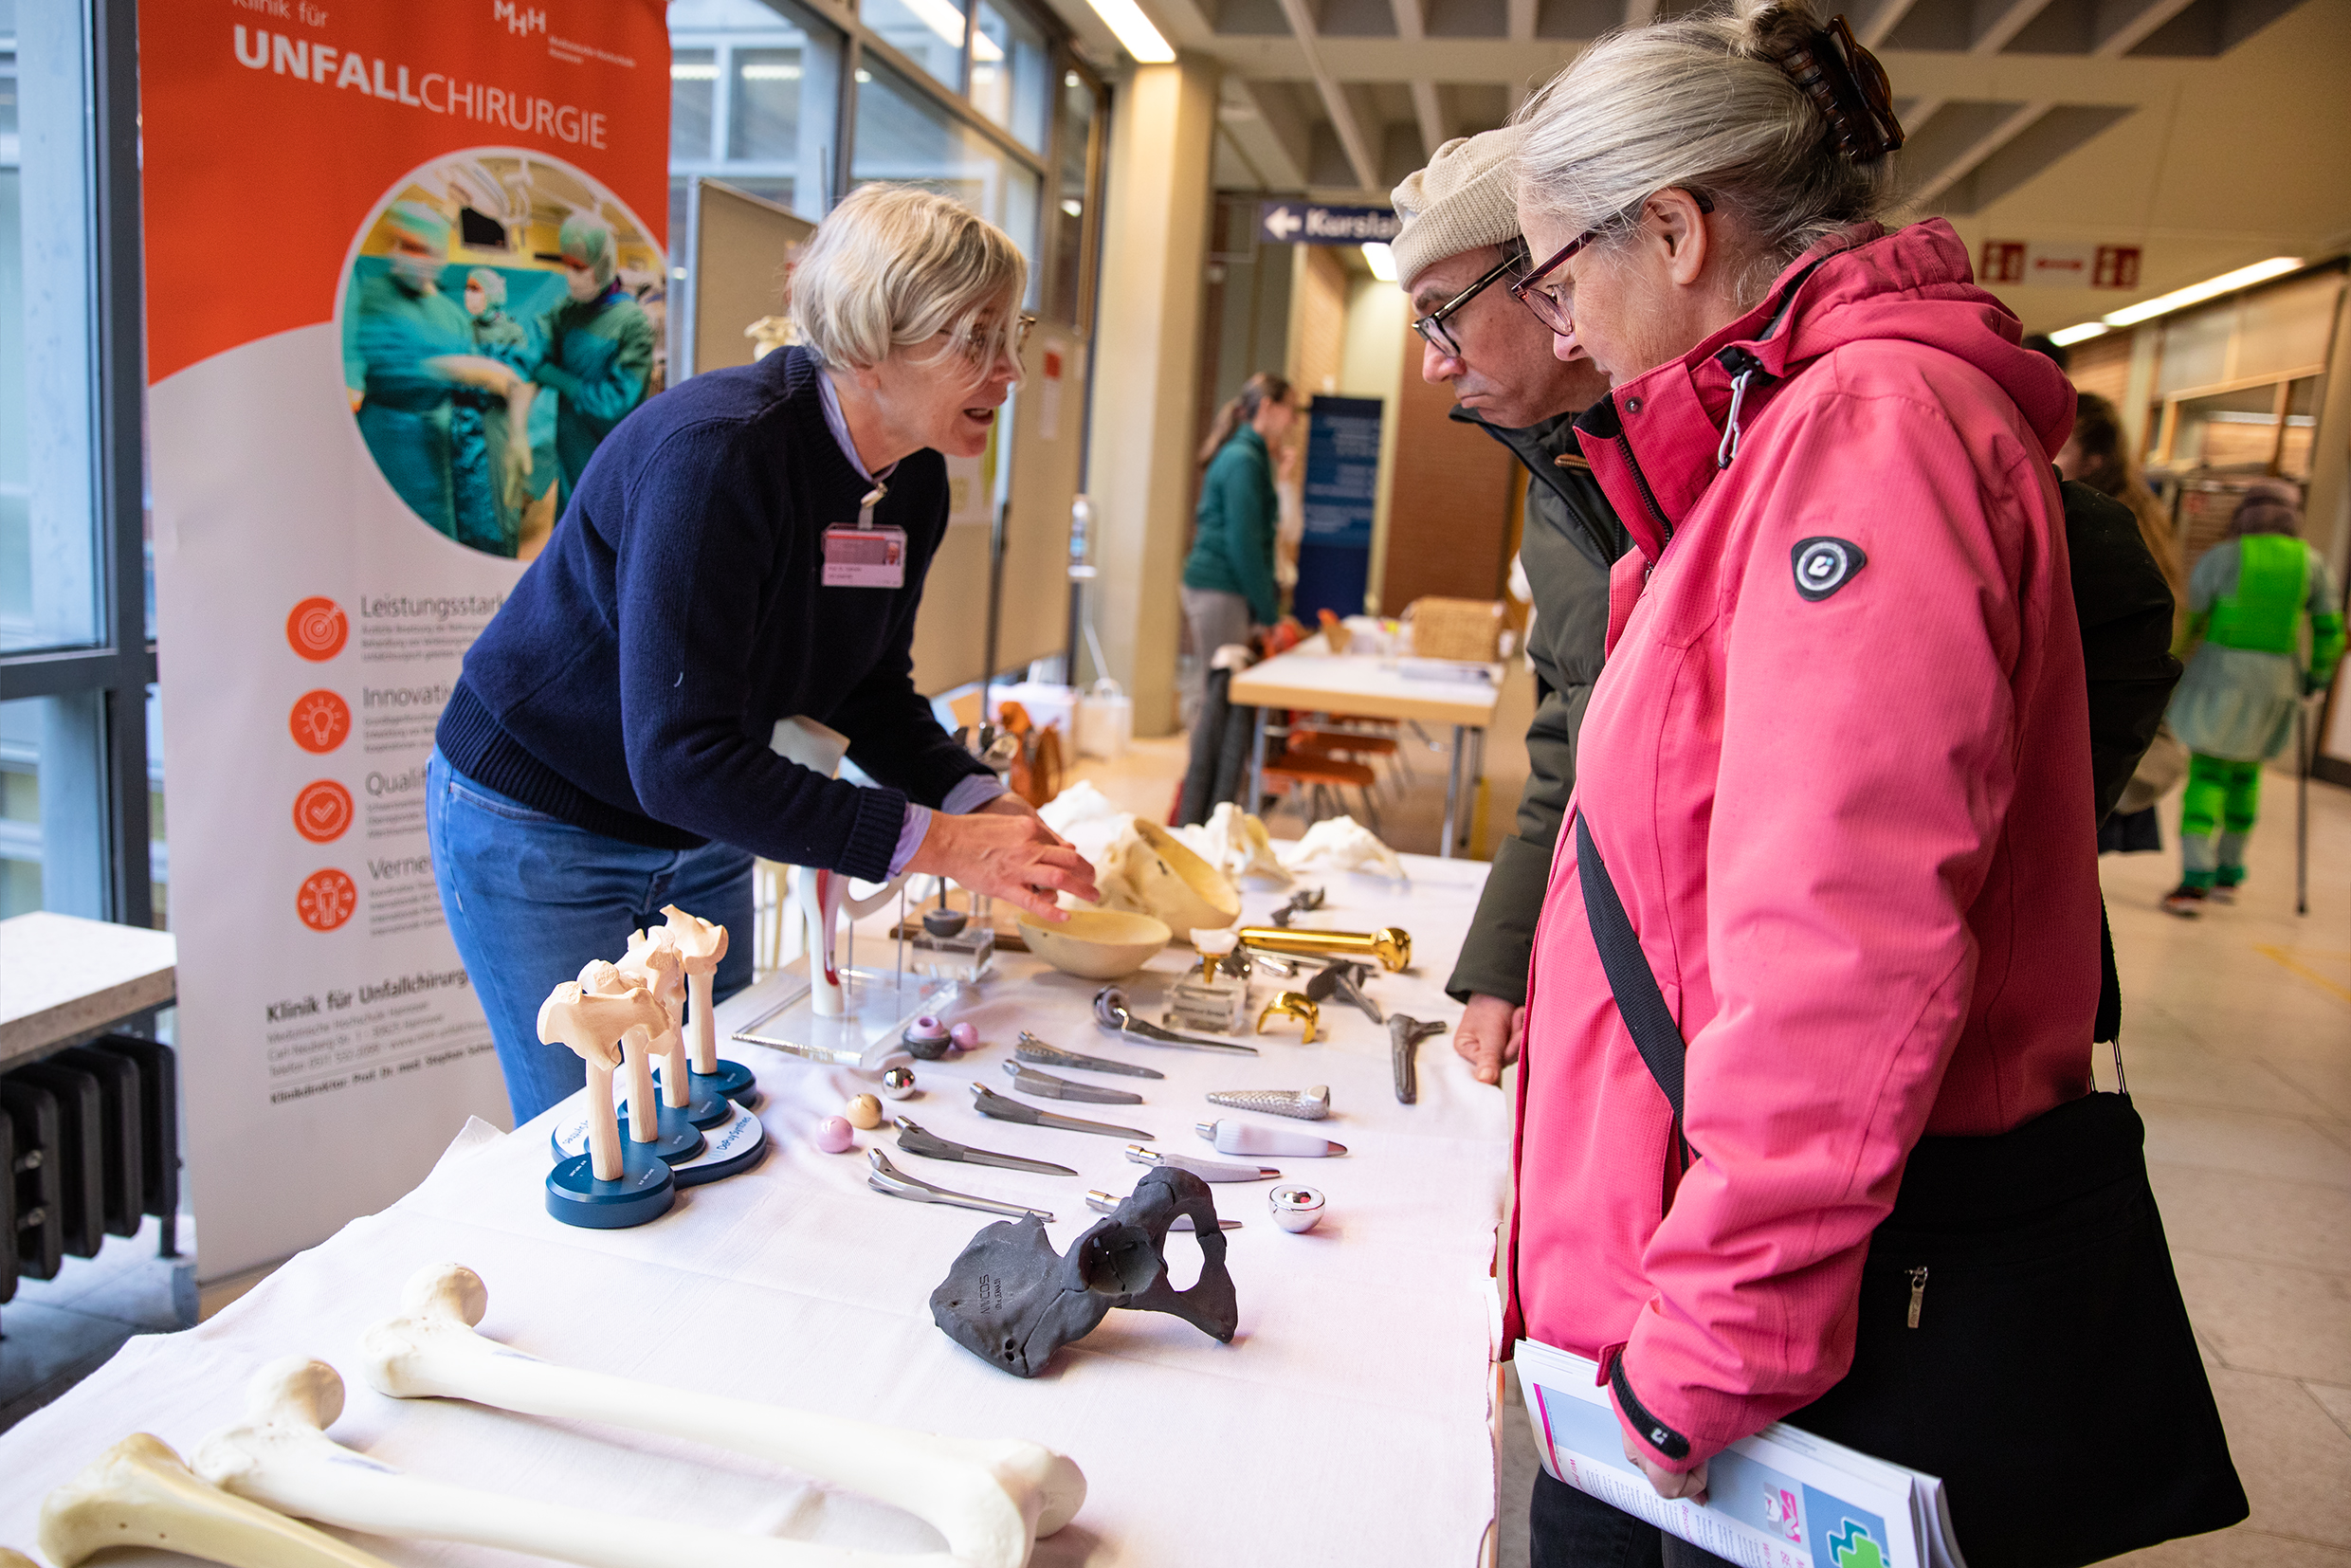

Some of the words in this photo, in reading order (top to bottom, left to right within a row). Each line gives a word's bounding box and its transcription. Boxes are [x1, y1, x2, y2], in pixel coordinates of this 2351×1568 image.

[298, 1, 328, 27] für
[494, 0, 546, 37] MHH
[233, 24, 608, 150] UNFALLCHIRURGIE
[367, 855, 433, 881] Verne
[266, 994, 320, 1023] Klinik
[327, 989, 354, 1011] für
